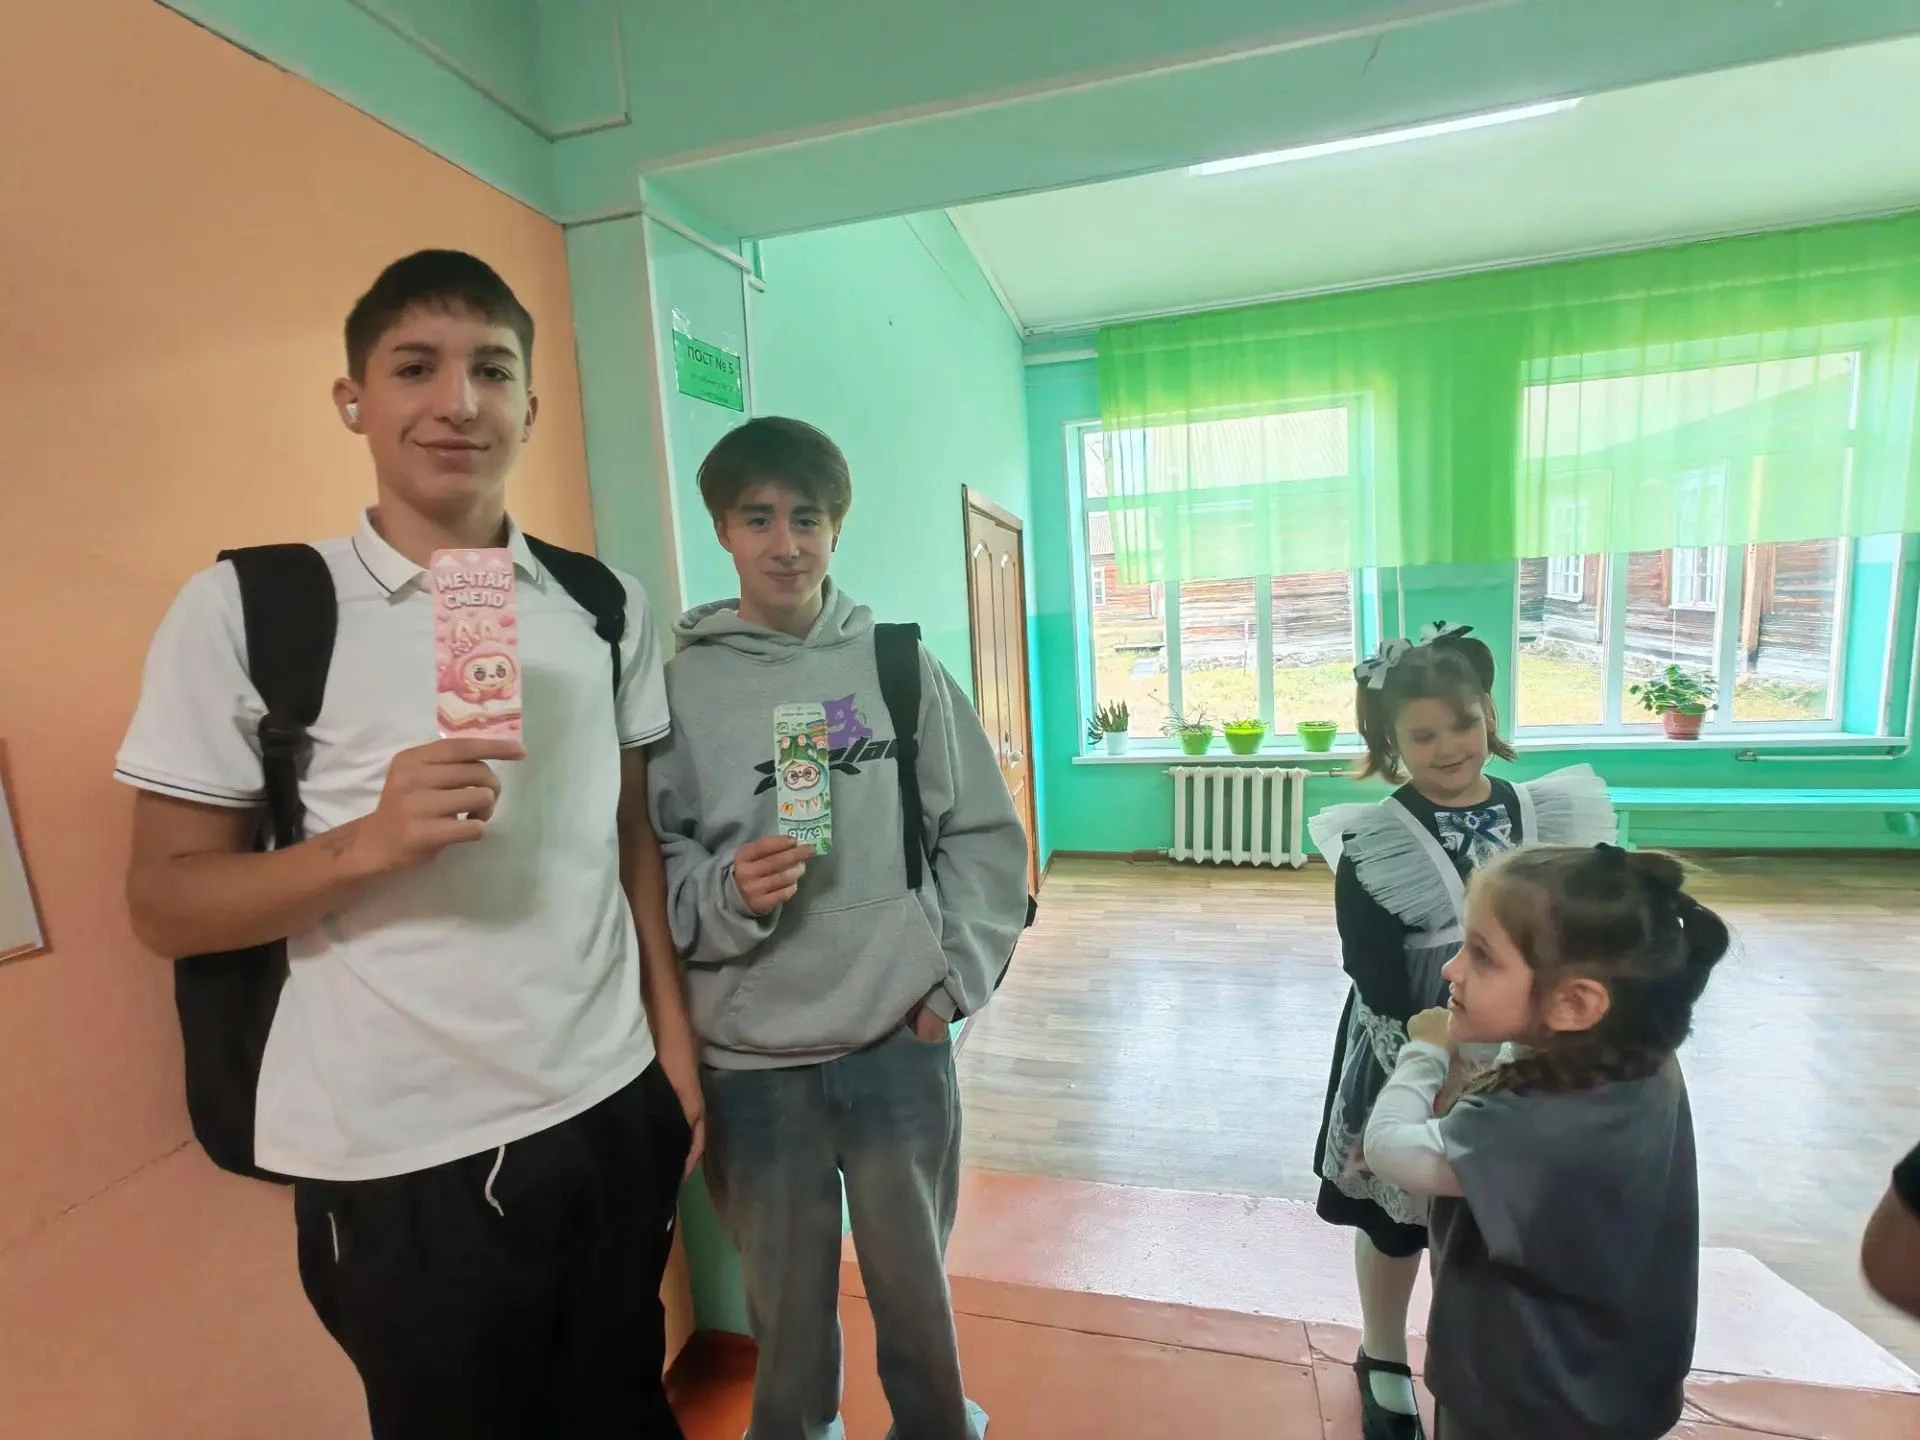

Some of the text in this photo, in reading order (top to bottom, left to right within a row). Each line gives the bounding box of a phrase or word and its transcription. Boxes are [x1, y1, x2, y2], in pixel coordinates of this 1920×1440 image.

[687, 347, 713, 366] ПОСТ
[728, 362, 735, 374] 5
[435, 571, 511, 593] МЕЧТАЙ
[444, 591, 505, 609] СМЕЛО
